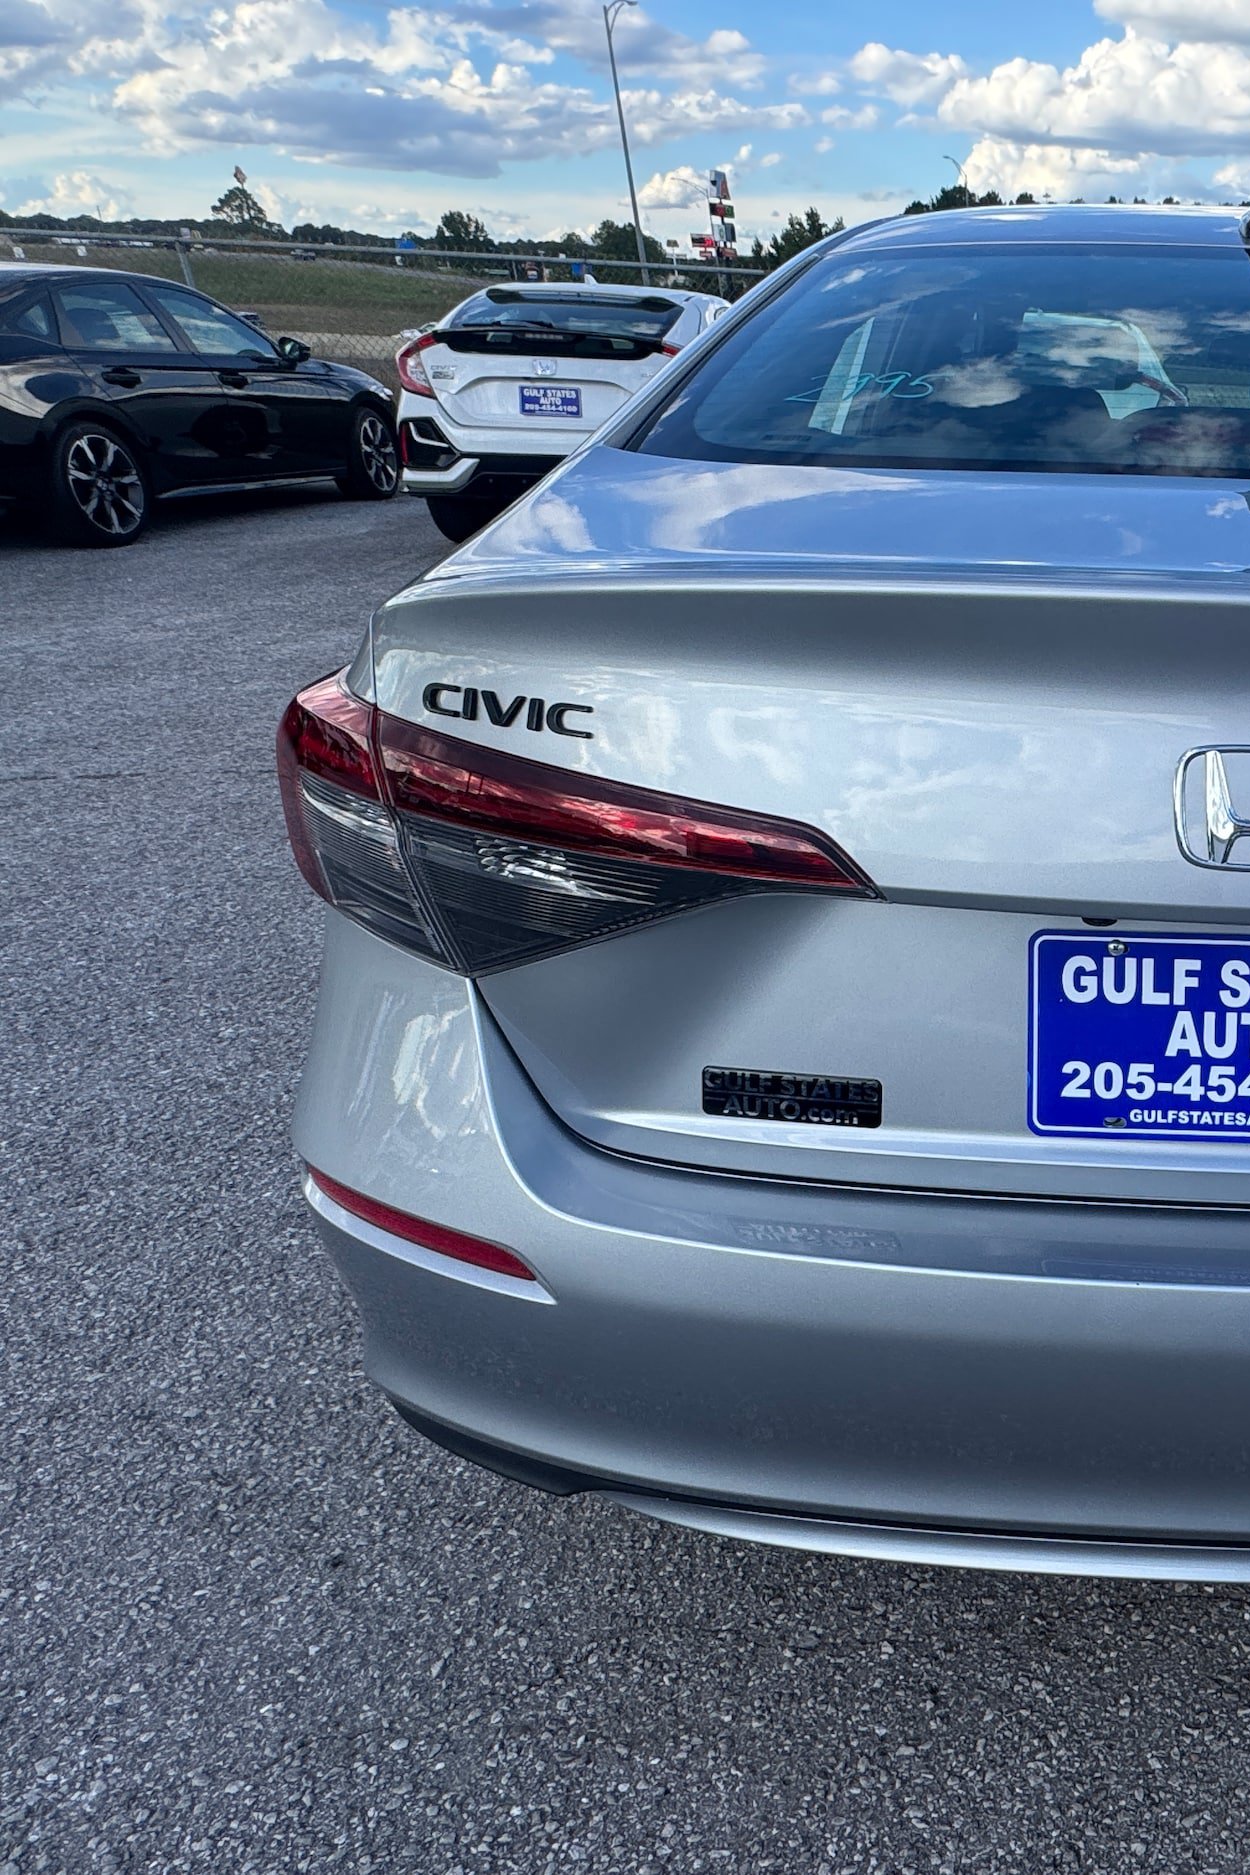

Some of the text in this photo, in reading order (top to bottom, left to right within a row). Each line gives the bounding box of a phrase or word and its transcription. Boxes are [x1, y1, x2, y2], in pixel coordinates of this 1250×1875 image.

[523, 388, 577, 399] GULF STATES
[539, 397, 562, 405] AUTO
[422, 682, 594, 739] CIVIC
[1061, 955, 1202, 1006] GULF
[704, 1070, 879, 1102] GULF STATES
[722, 1095, 859, 1125] AUTO.com
